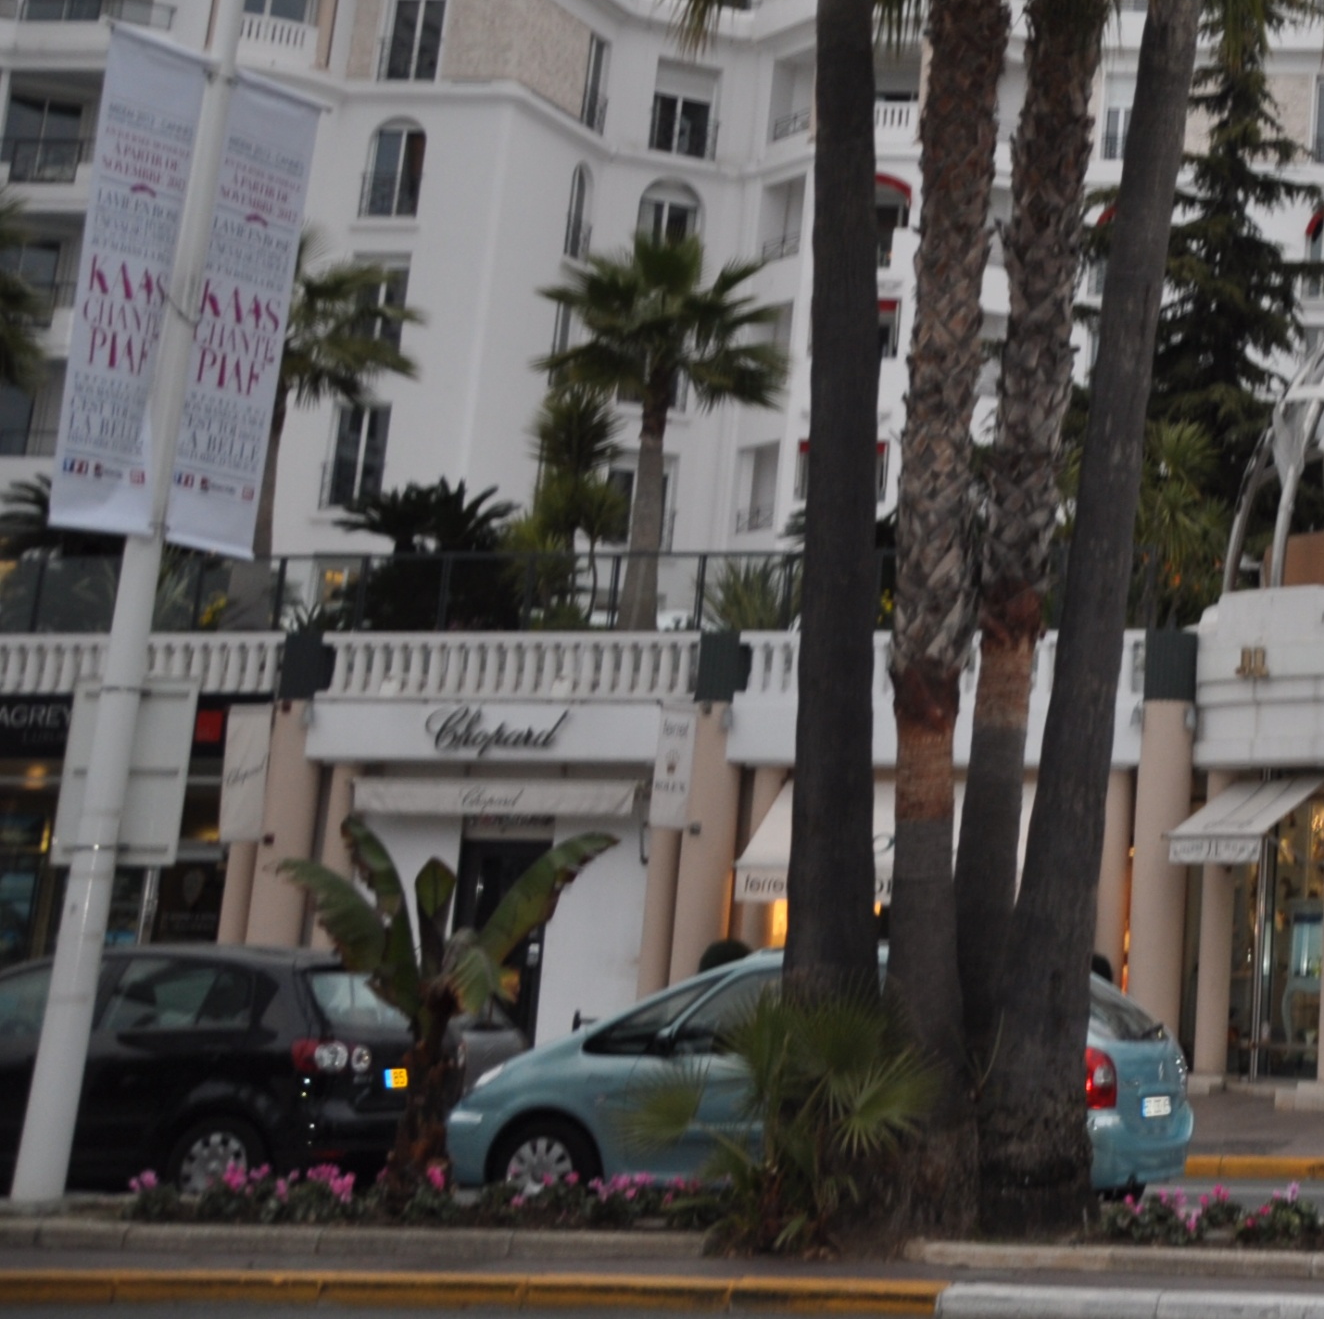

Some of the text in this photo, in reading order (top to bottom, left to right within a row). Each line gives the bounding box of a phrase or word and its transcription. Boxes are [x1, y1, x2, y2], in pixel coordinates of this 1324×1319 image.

[87, 253, 168, 307] KAAS
[199, 278, 280, 333] KAAS
[88, 325, 151, 376] PIAF
[196, 345, 266, 396] PIAF
[425, 704, 569, 757] Chopard
